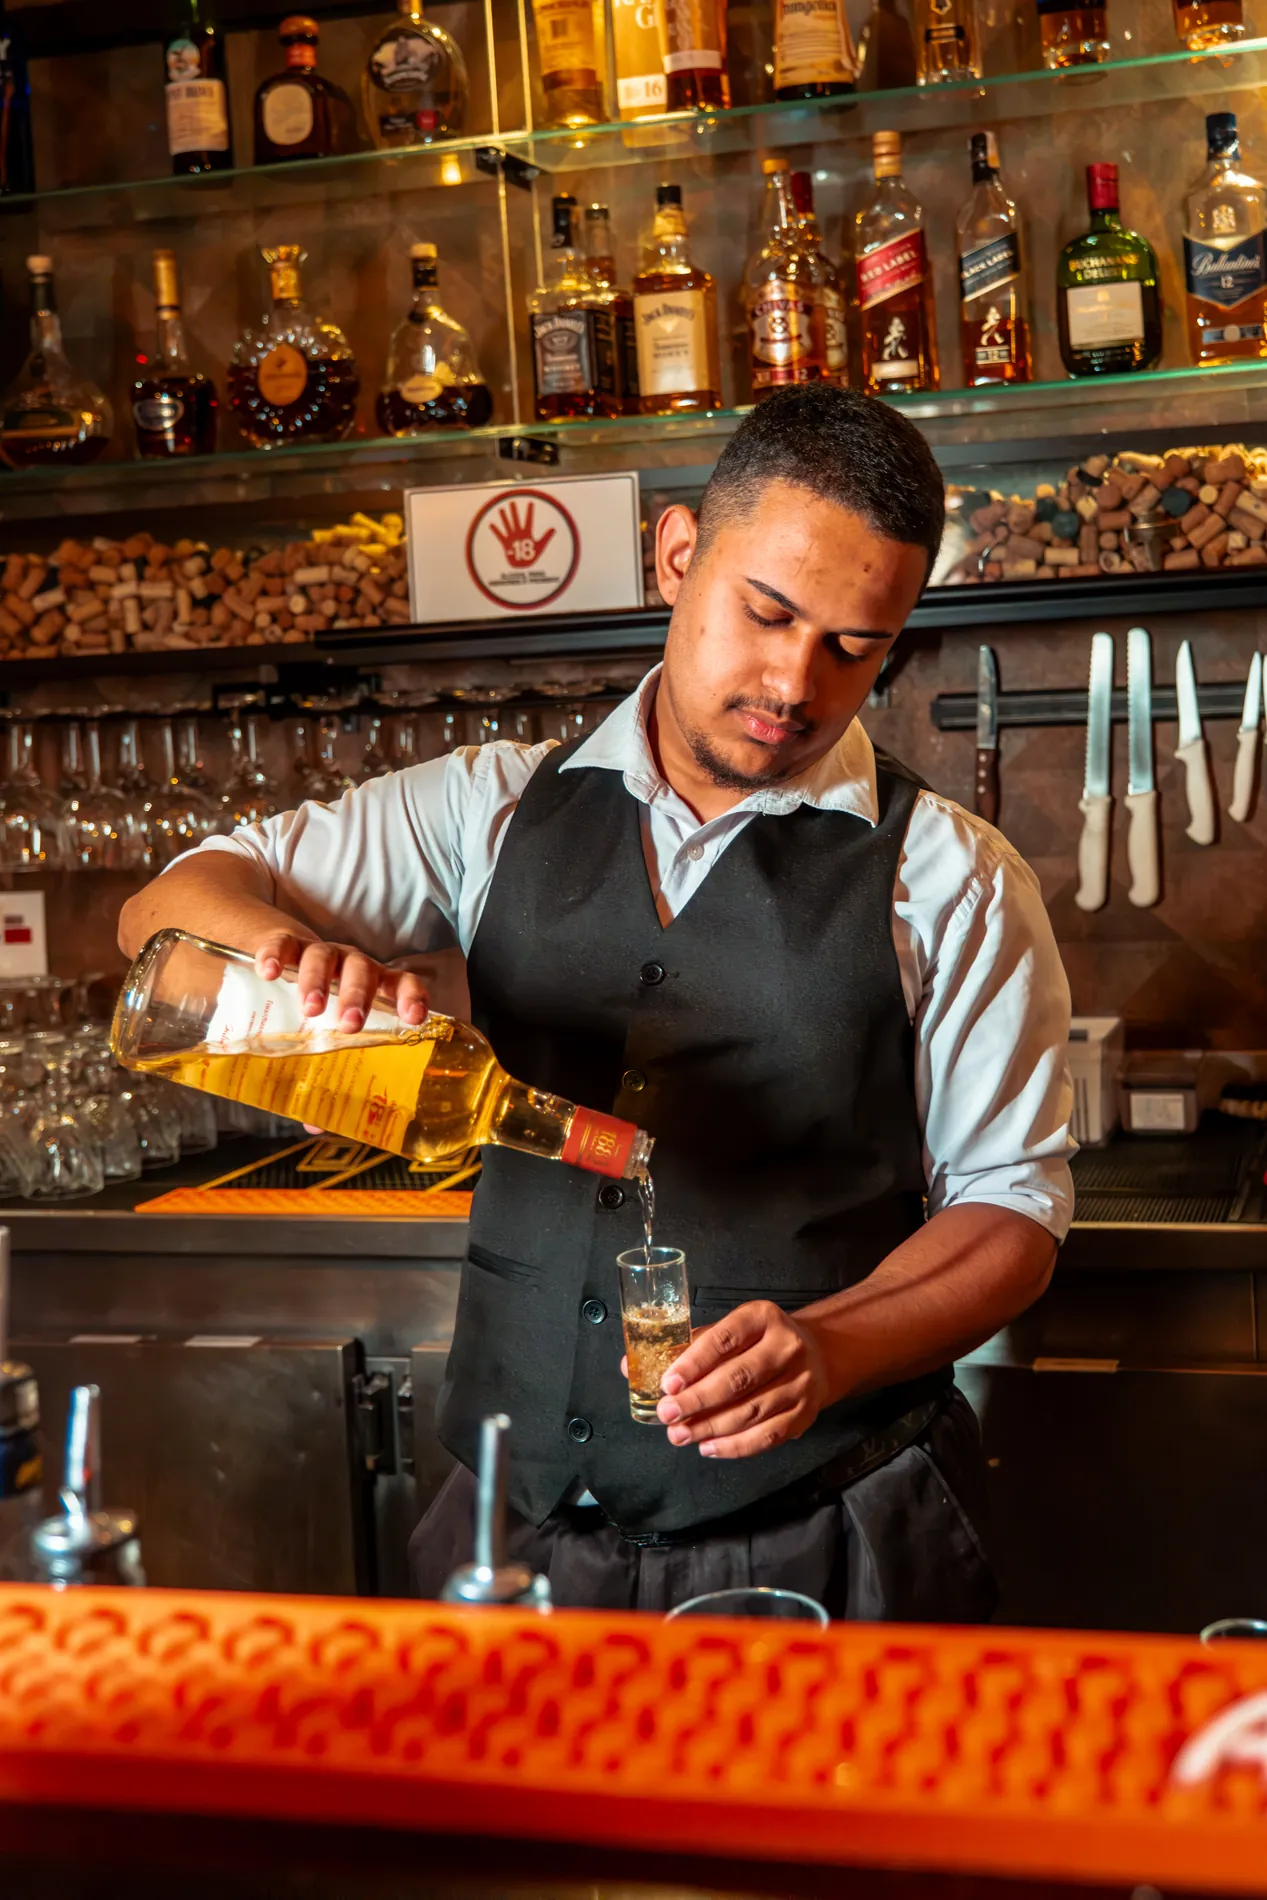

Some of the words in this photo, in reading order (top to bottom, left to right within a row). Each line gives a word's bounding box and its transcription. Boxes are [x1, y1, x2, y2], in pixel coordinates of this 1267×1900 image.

[860, 266, 882, 283] RED
[882, 250, 917, 272] LABEL
[961, 262, 987, 280] LACK
[1190, 252, 1261, 276] Ballantine's
[1221, 275, 1234, 289] 12
[754, 300, 805, 317] CHIVAS
